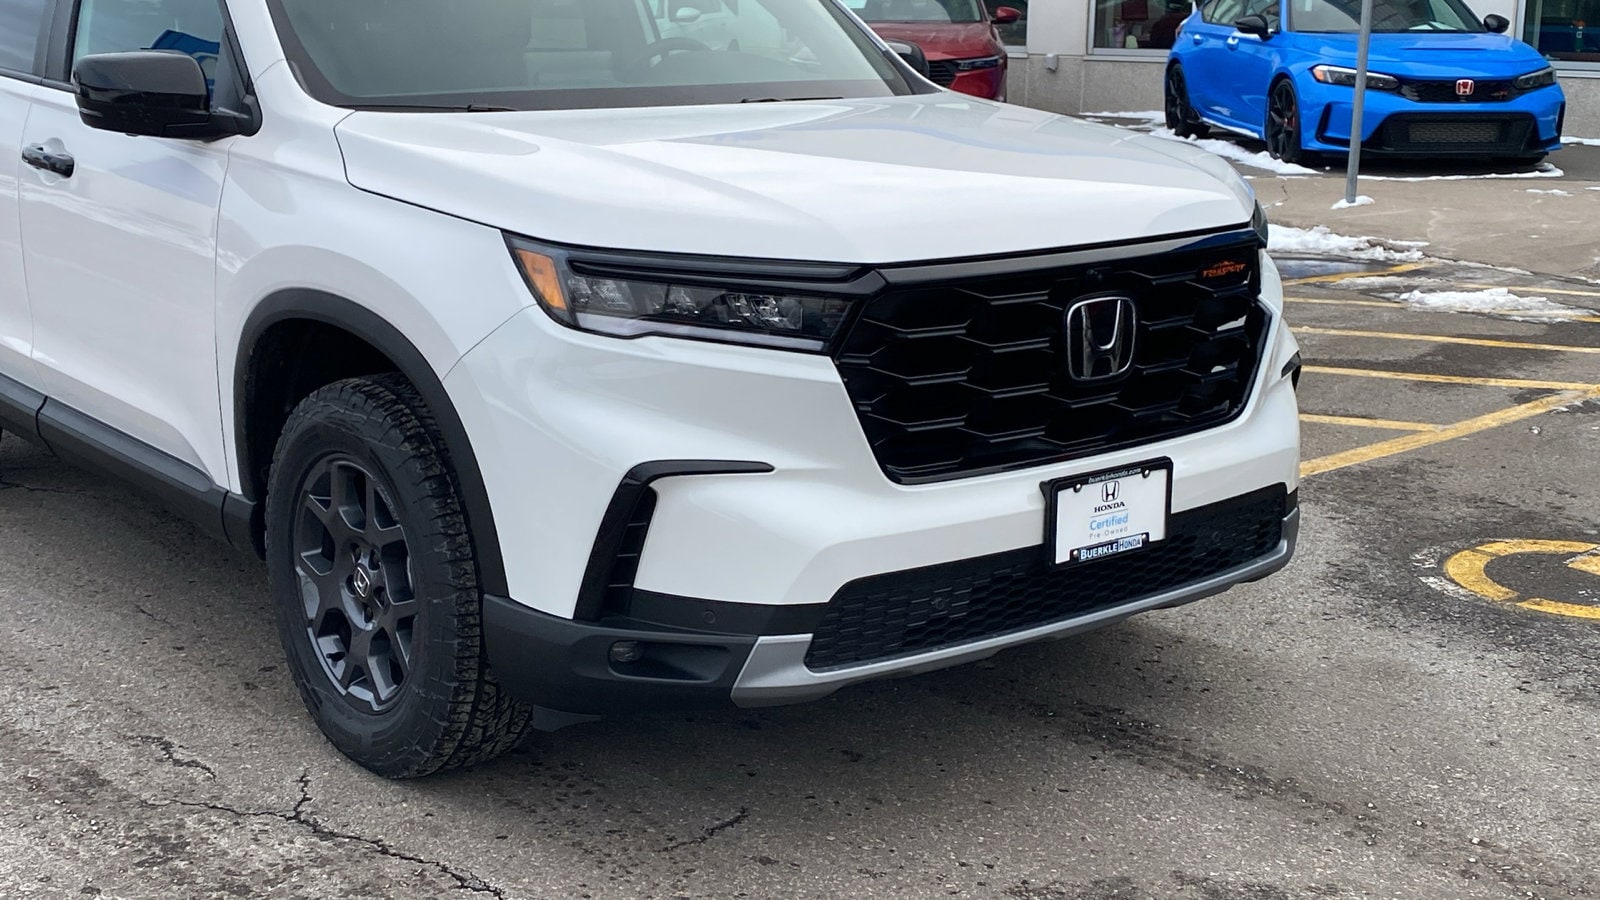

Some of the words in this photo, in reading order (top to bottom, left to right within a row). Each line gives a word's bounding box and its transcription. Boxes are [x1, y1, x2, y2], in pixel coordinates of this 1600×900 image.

[1094, 501, 1125, 513] HONDA
[1090, 512, 1129, 531] Certified
[1080, 543, 1118, 560] BUERKLE
[1118, 537, 1140, 552] HONDA
